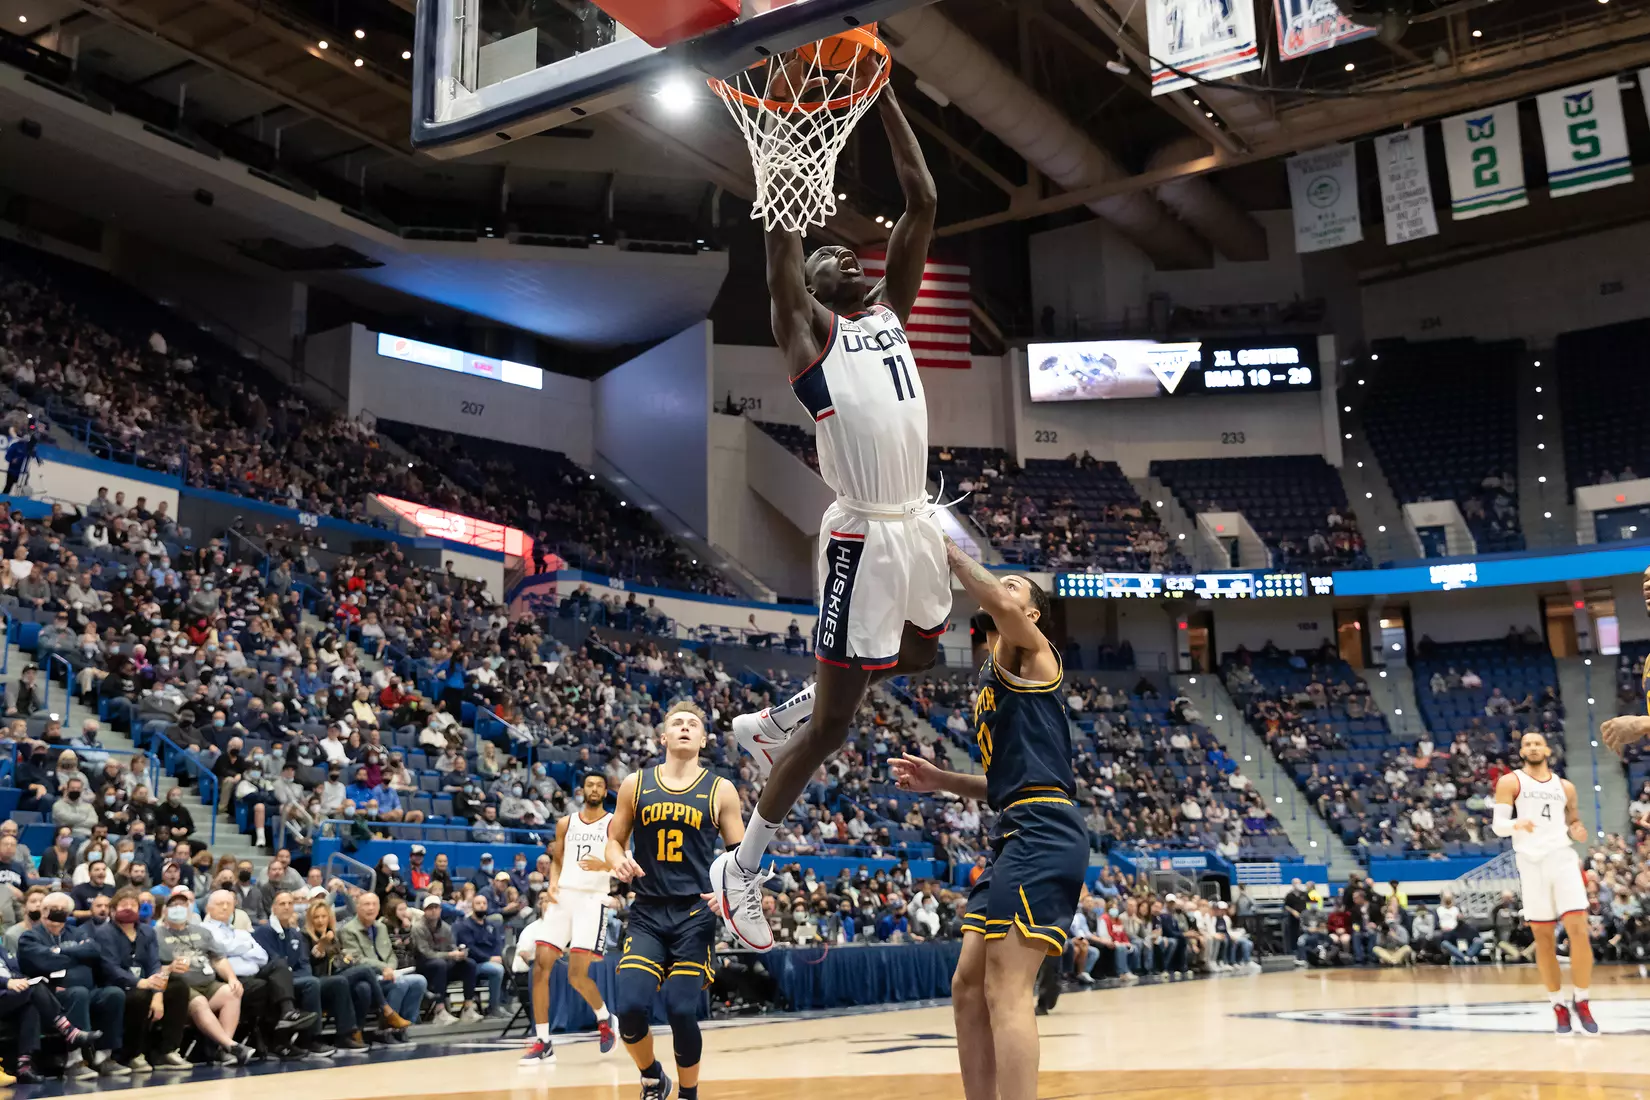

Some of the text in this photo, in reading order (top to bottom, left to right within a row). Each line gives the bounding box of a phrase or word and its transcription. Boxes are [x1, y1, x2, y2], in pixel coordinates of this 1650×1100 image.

[1568, 119, 1601, 161] 5
[1471, 145, 1499, 188] 2
[1213, 350, 1236, 366] XL
[1237, 347, 1299, 365] CENTER
[882, 354, 916, 401] 11
[1204, 370, 1244, 387] MAR
[461, 400, 485, 416] 207
[740, 397, 762, 410] 231
[1035, 430, 1058, 443] 232
[1221, 431, 1246, 444] 233
[298, 512, 318, 527] 105
[823, 545, 851, 648] HUSKIES
[1523, 791, 1565, 801] UCONN
[641, 802, 703, 830] COPPIN
[1541, 804, 1551, 820] 4
[568, 833, 605, 843] UCONN
[657, 829, 683, 862] 12
[576, 845, 592, 861] 12
